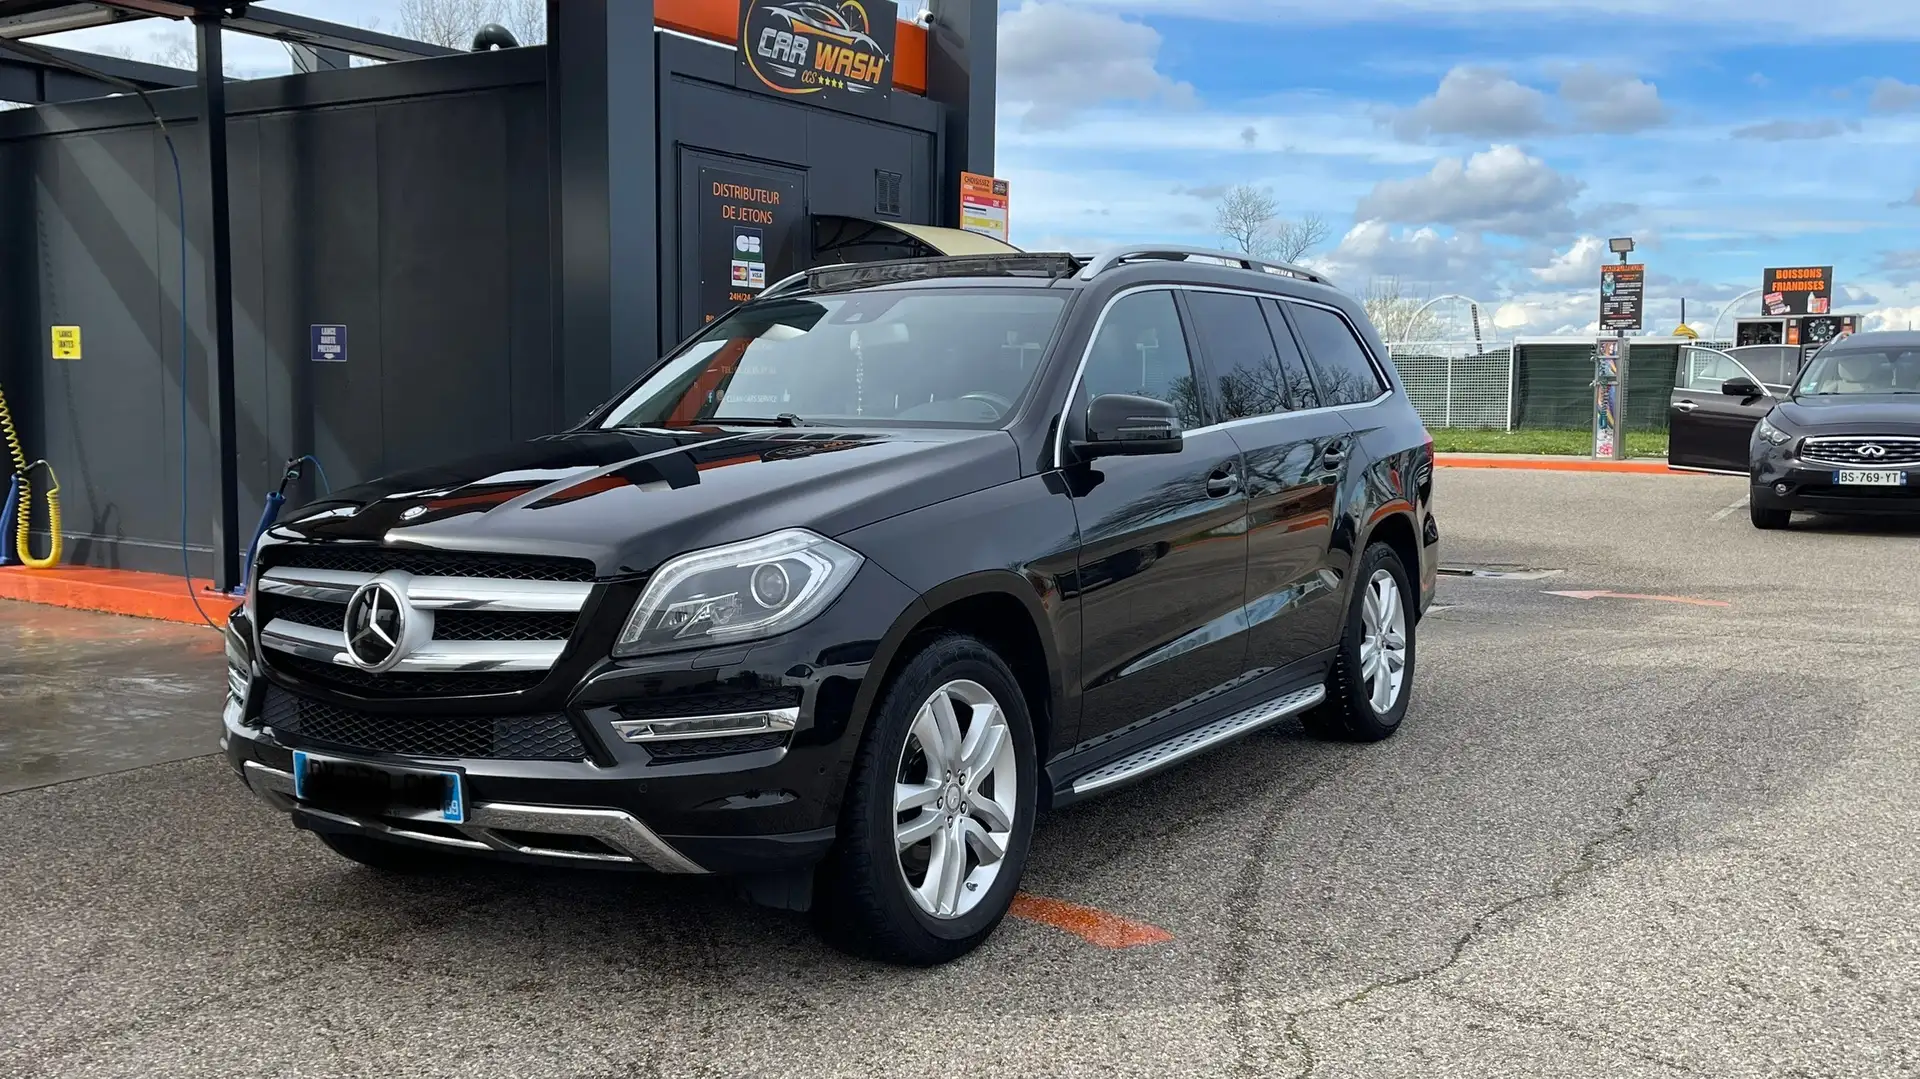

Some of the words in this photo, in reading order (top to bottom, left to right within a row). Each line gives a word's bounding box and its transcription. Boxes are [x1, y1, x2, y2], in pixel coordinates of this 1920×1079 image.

[757, 27, 809, 66] CAR
[814, 41, 884, 84] WASH
[713, 182, 780, 205] DISTRIBUTEUR
[722, 205, 736, 220] DE
[737, 207, 773, 225] JETONS
[1776, 268, 1822, 279] BOISSONS
[1772, 281, 1825, 292] FRIANDISES
[1841, 471, 1899, 483] BS-769-YT
